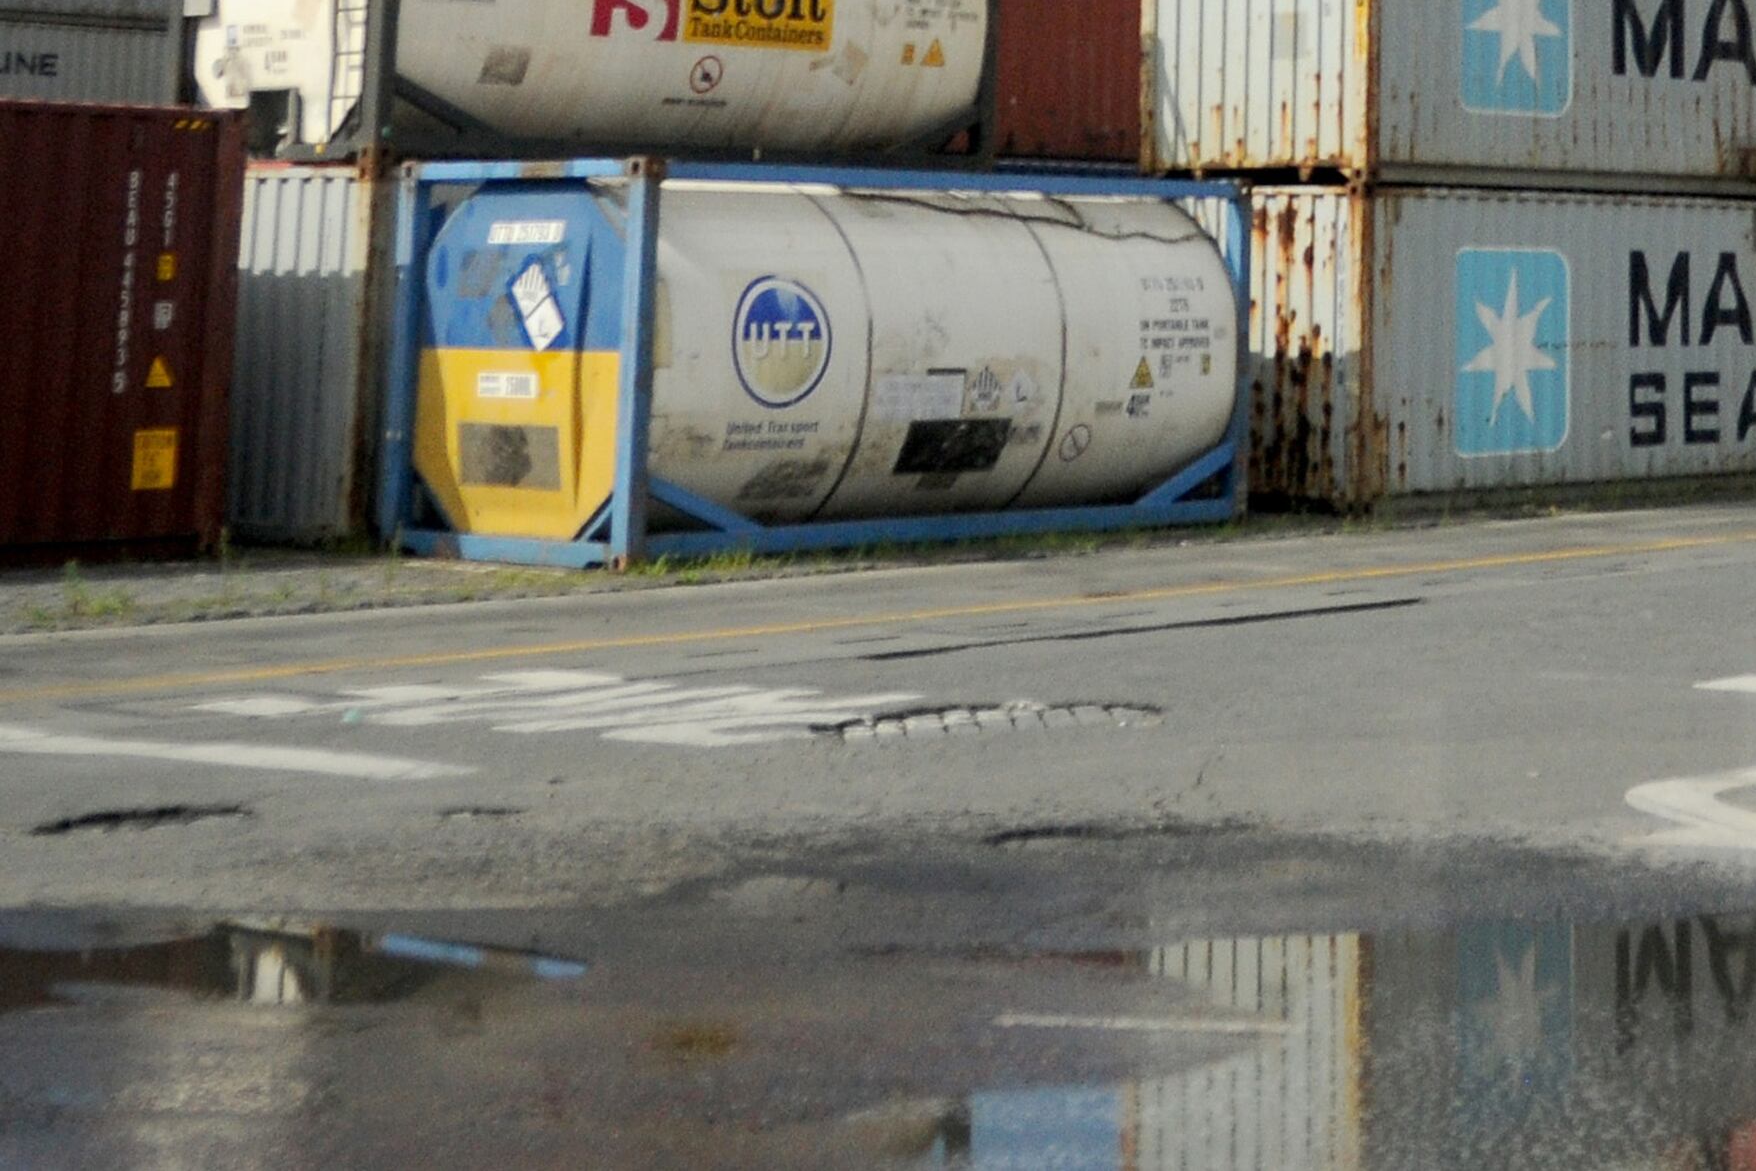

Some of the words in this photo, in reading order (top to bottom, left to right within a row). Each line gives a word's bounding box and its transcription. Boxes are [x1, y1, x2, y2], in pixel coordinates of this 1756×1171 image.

[689, 17, 732, 40] Tank
[734, 21, 825, 46] Containers
[750, 321, 816, 361] UTT
